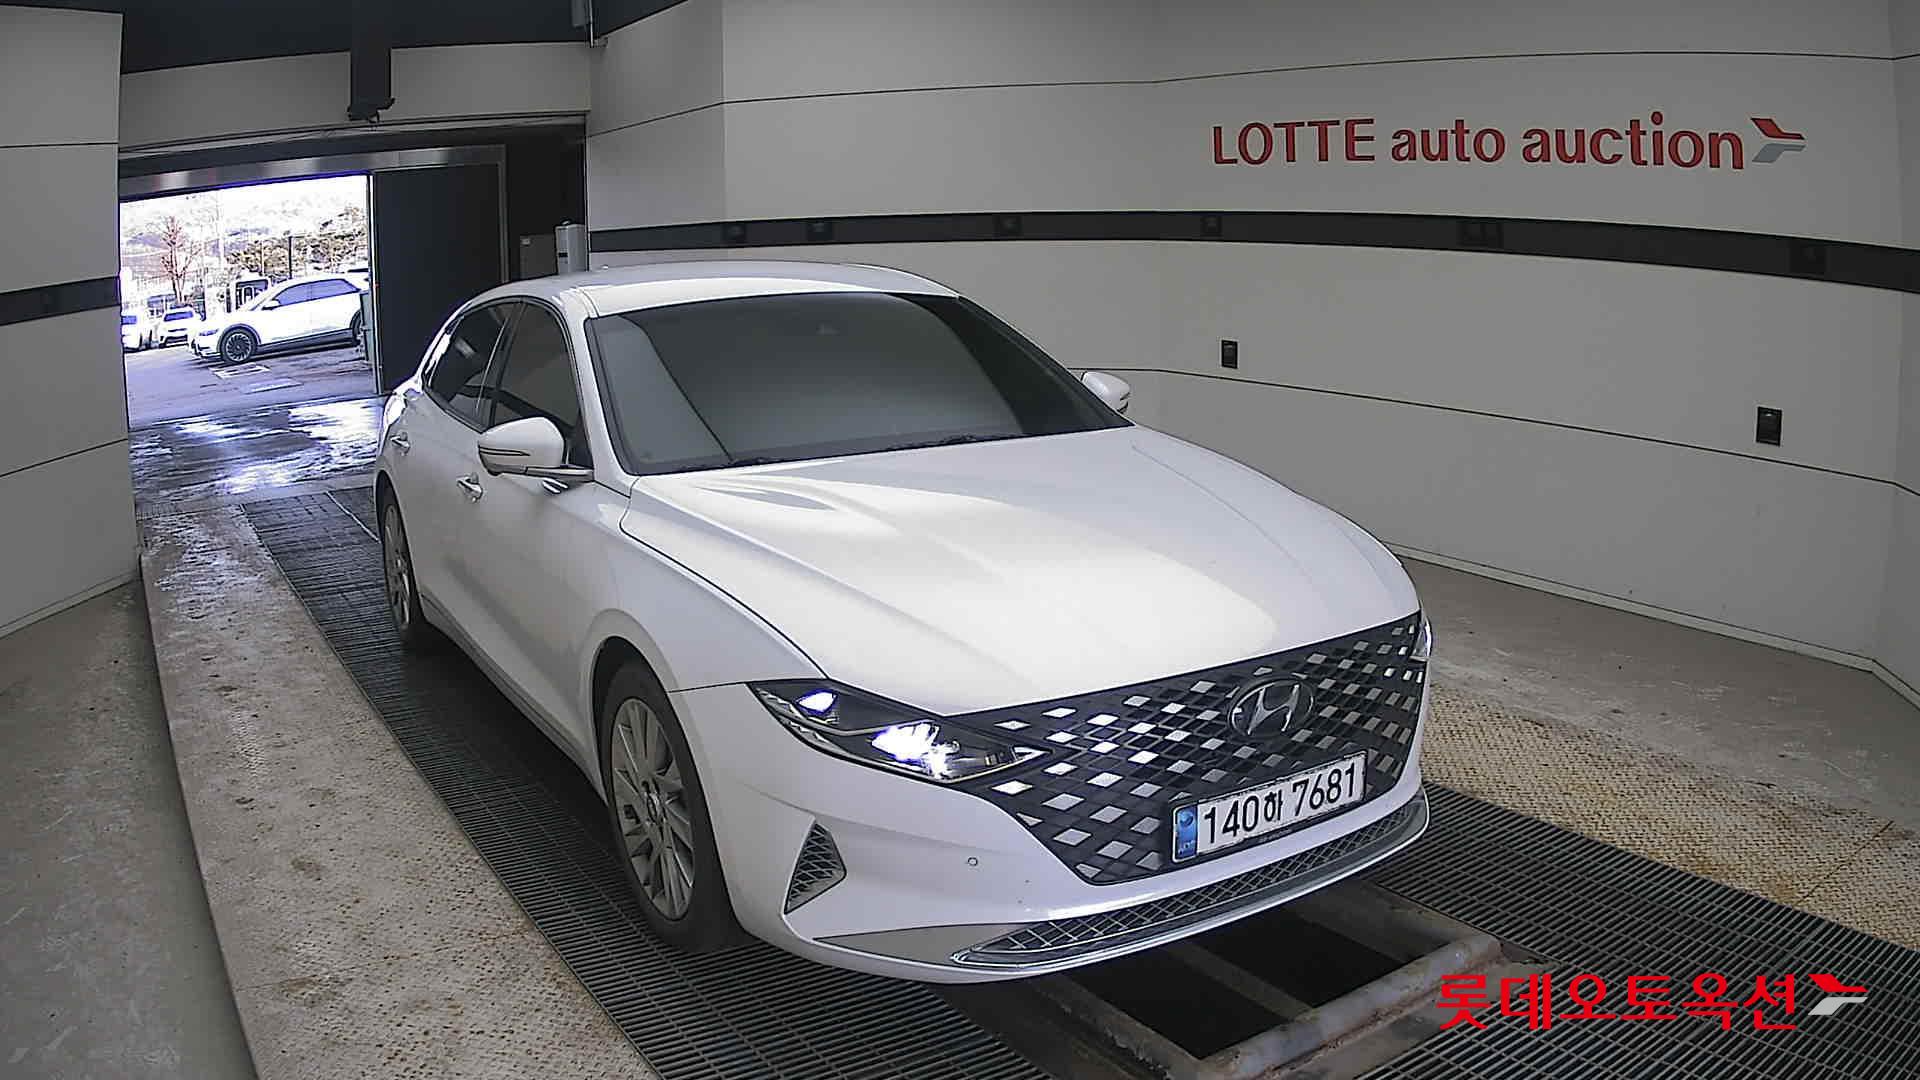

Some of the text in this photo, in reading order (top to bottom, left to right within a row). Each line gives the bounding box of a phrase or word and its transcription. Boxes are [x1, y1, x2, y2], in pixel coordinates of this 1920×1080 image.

[1212, 111, 1745, 170] LOTTE auto auction
[1203, 762, 1357, 844] 140하 7681
